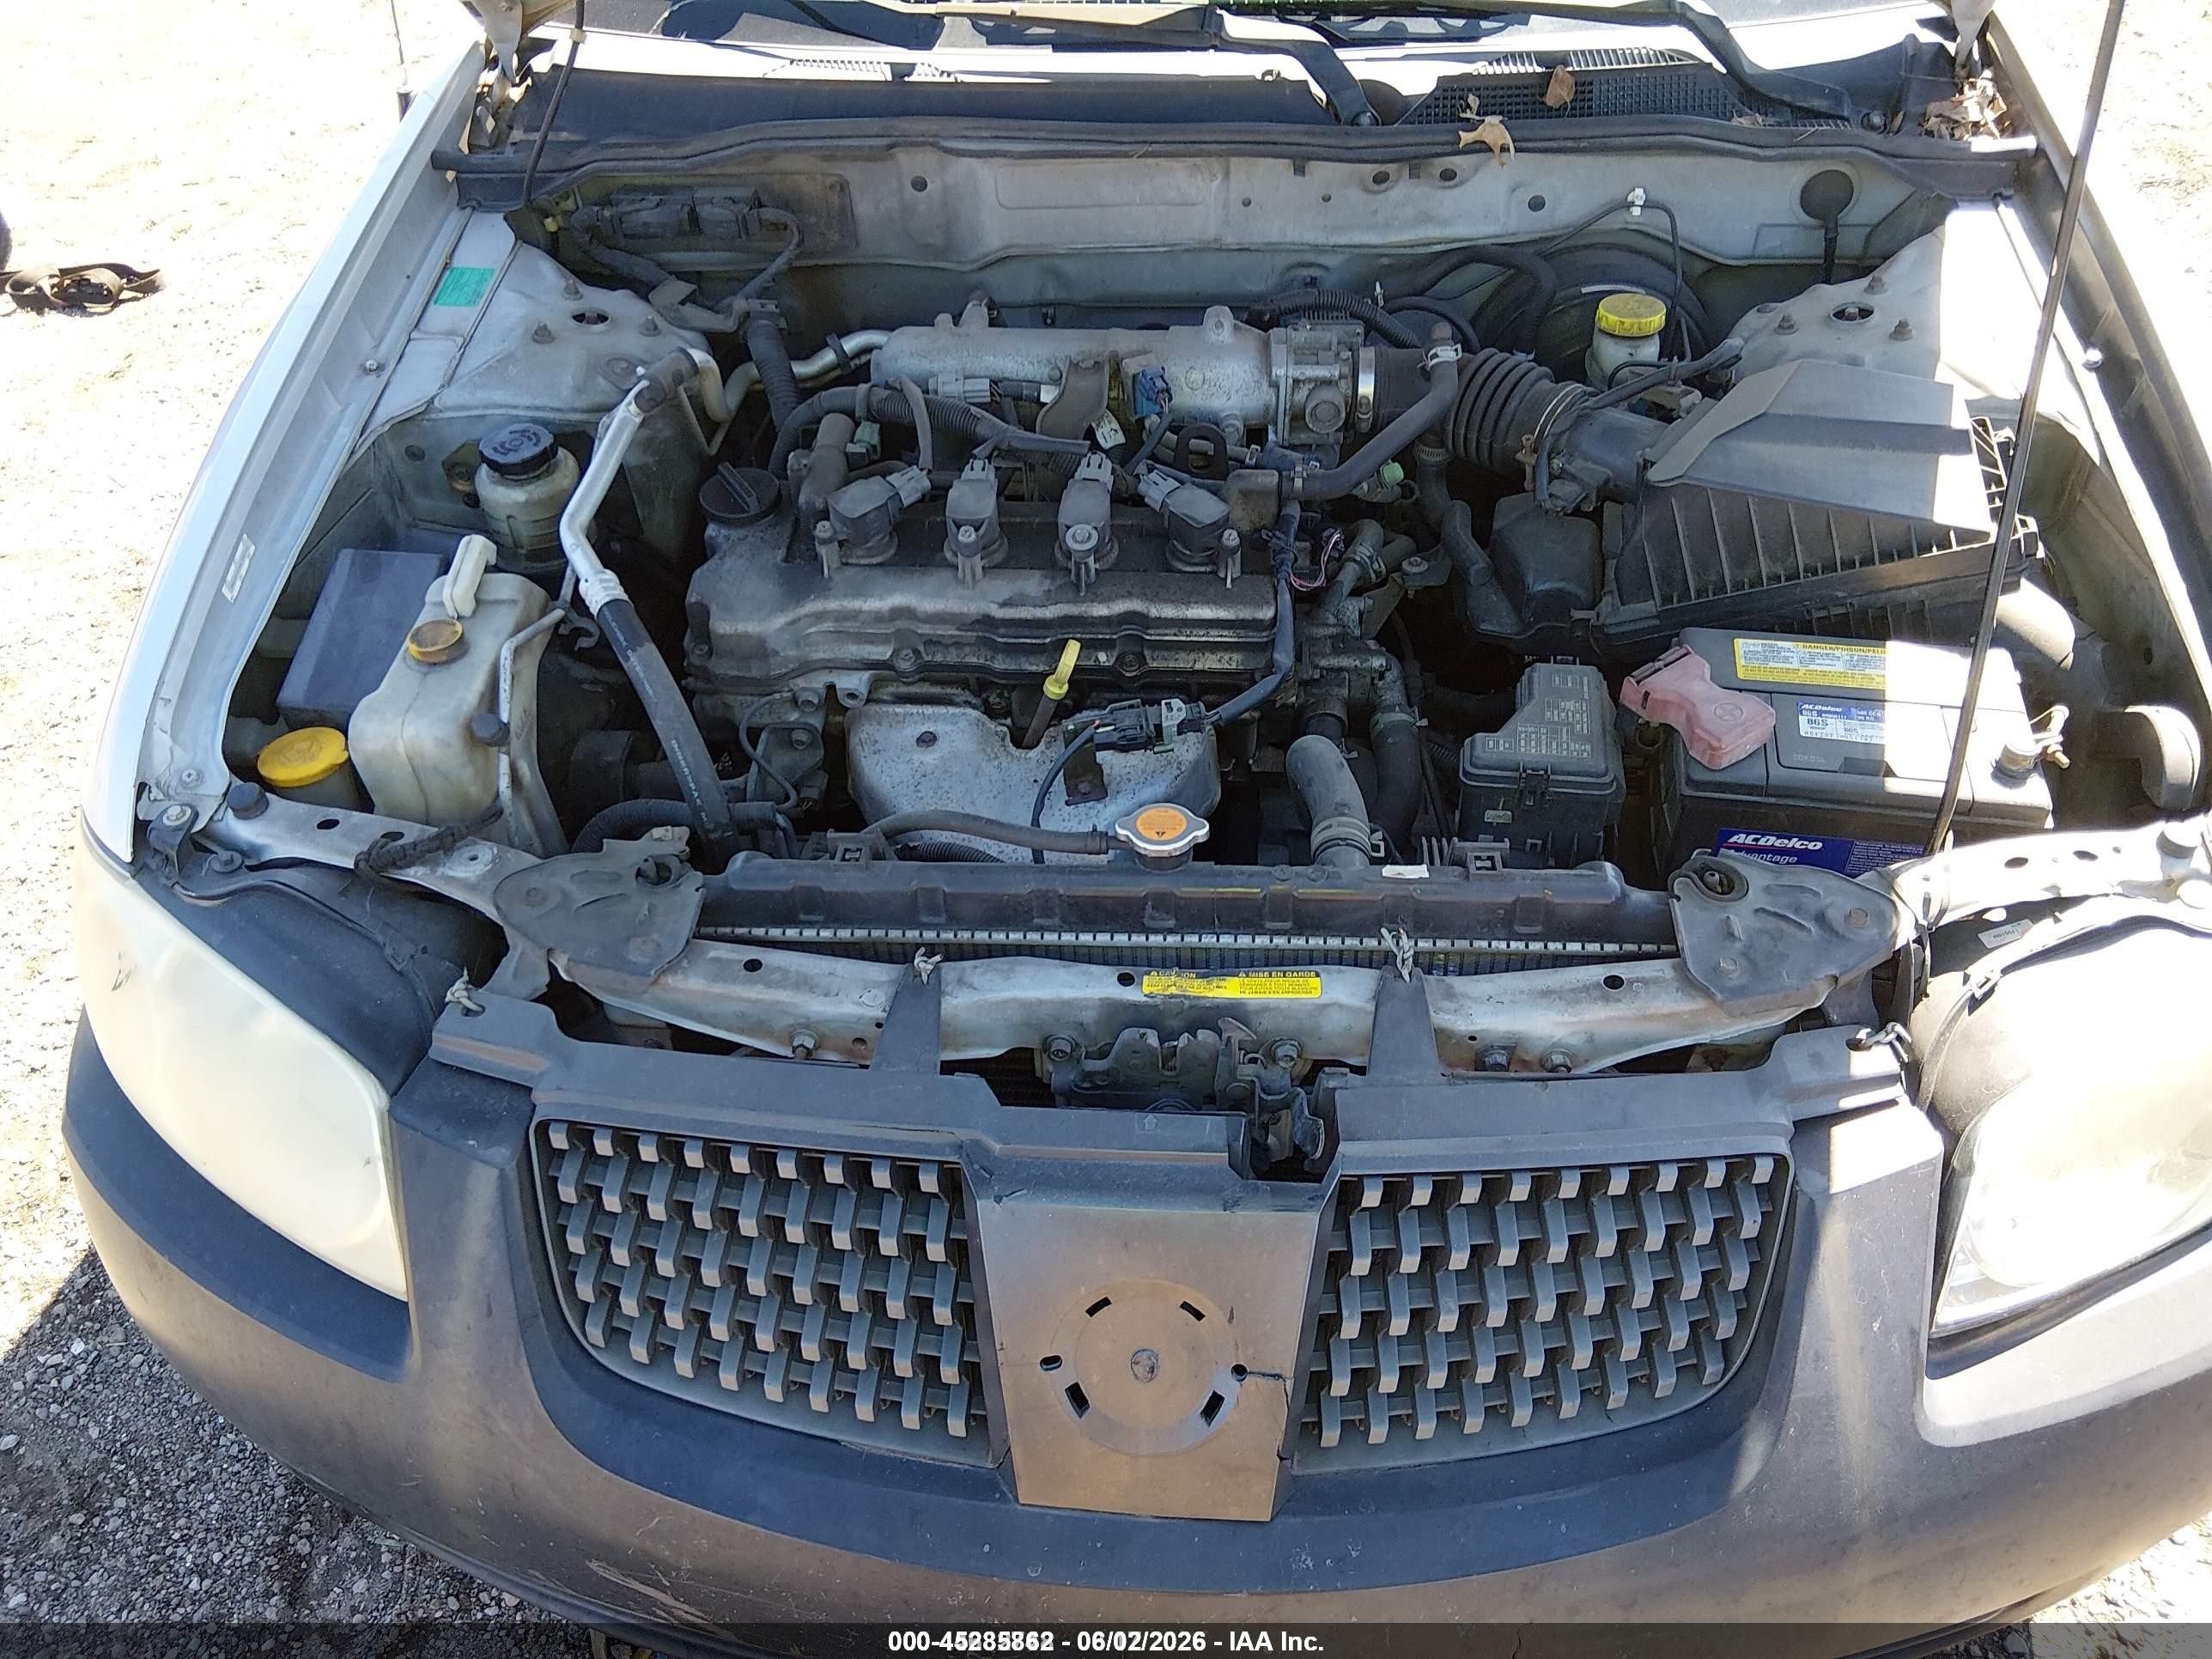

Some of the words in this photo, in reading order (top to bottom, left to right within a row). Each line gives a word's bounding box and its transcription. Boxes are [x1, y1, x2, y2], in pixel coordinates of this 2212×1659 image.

[1801, 644, 1887, 654] DANGER/POISON/PELI
[1801, 703, 1843, 713] ACDelco
[1807, 717, 1828, 726] 86S
[1727, 833, 1823, 850] ACDelco
[1731, 849, 1798, 864] vantage
